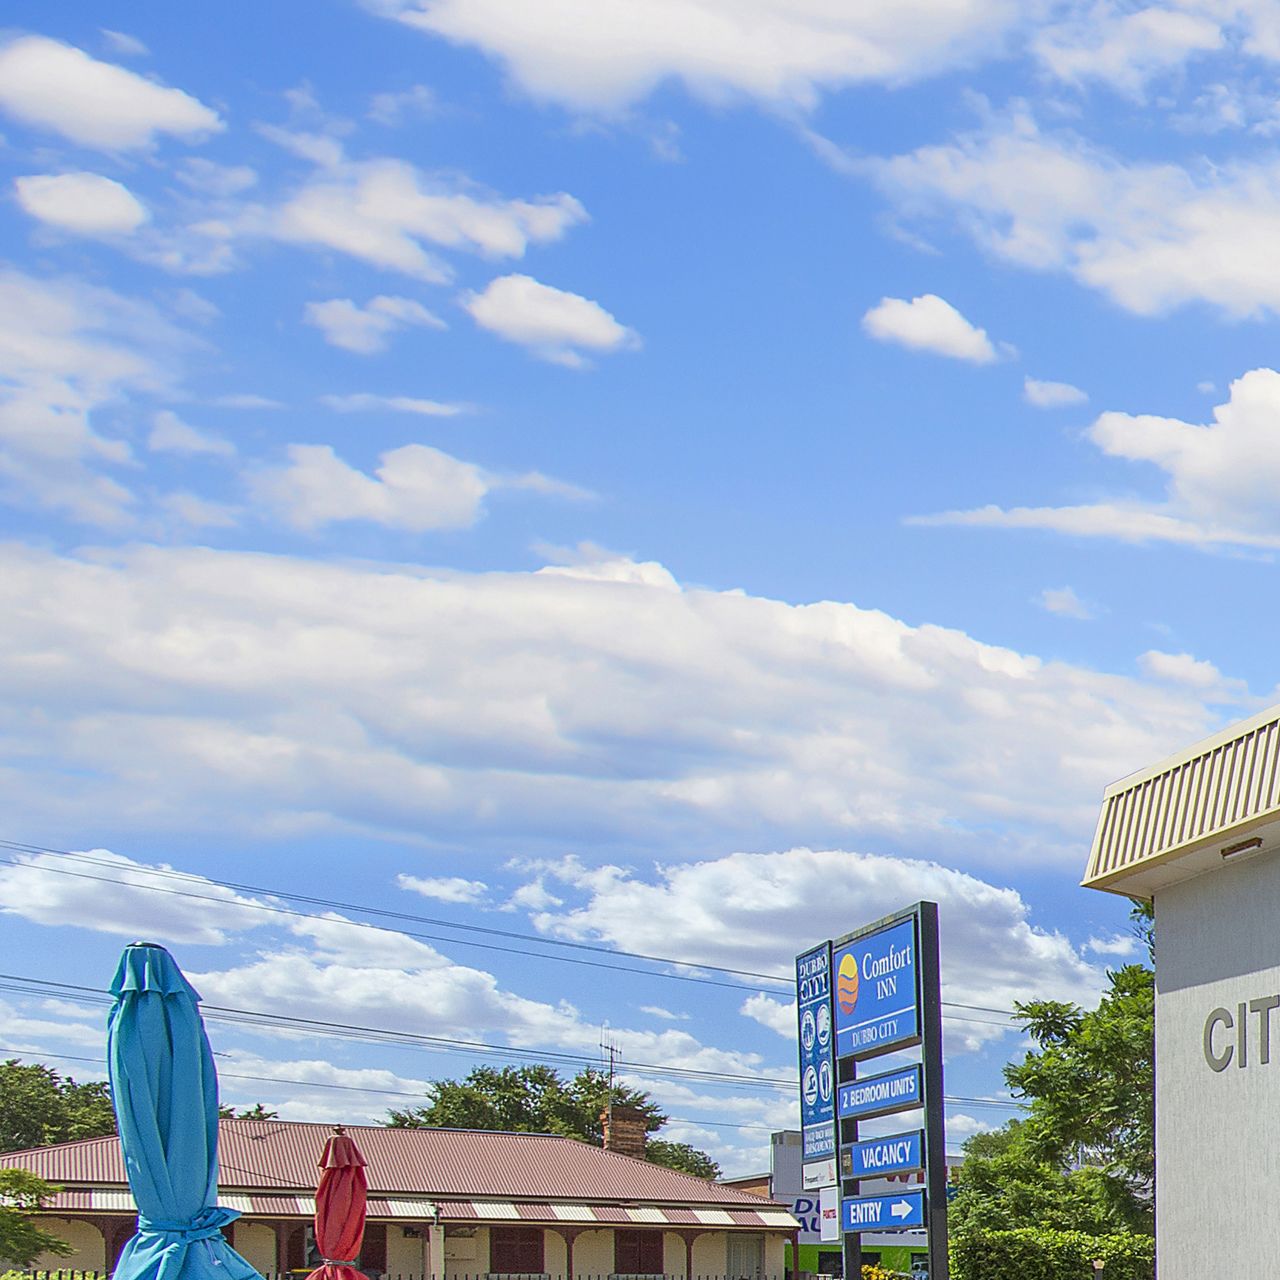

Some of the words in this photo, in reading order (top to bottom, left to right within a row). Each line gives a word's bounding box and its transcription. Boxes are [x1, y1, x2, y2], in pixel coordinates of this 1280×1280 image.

[800, 954, 828, 978] DUBBO
[862, 944, 912, 980] Comfort
[800, 971, 829, 1000] CITY
[877, 976, 897, 1000] INN
[852, 1026, 877, 1047] DUBBO
[879, 1019, 898, 1039] CITY
[842, 1093, 849, 1108] 2
[850, 1082, 890, 1107] BEDROOM
[890, 1075, 915, 1097] UNITS
[862, 1141, 912, 1169] VACANCY
[850, 1201, 882, 1224] ENTRY
